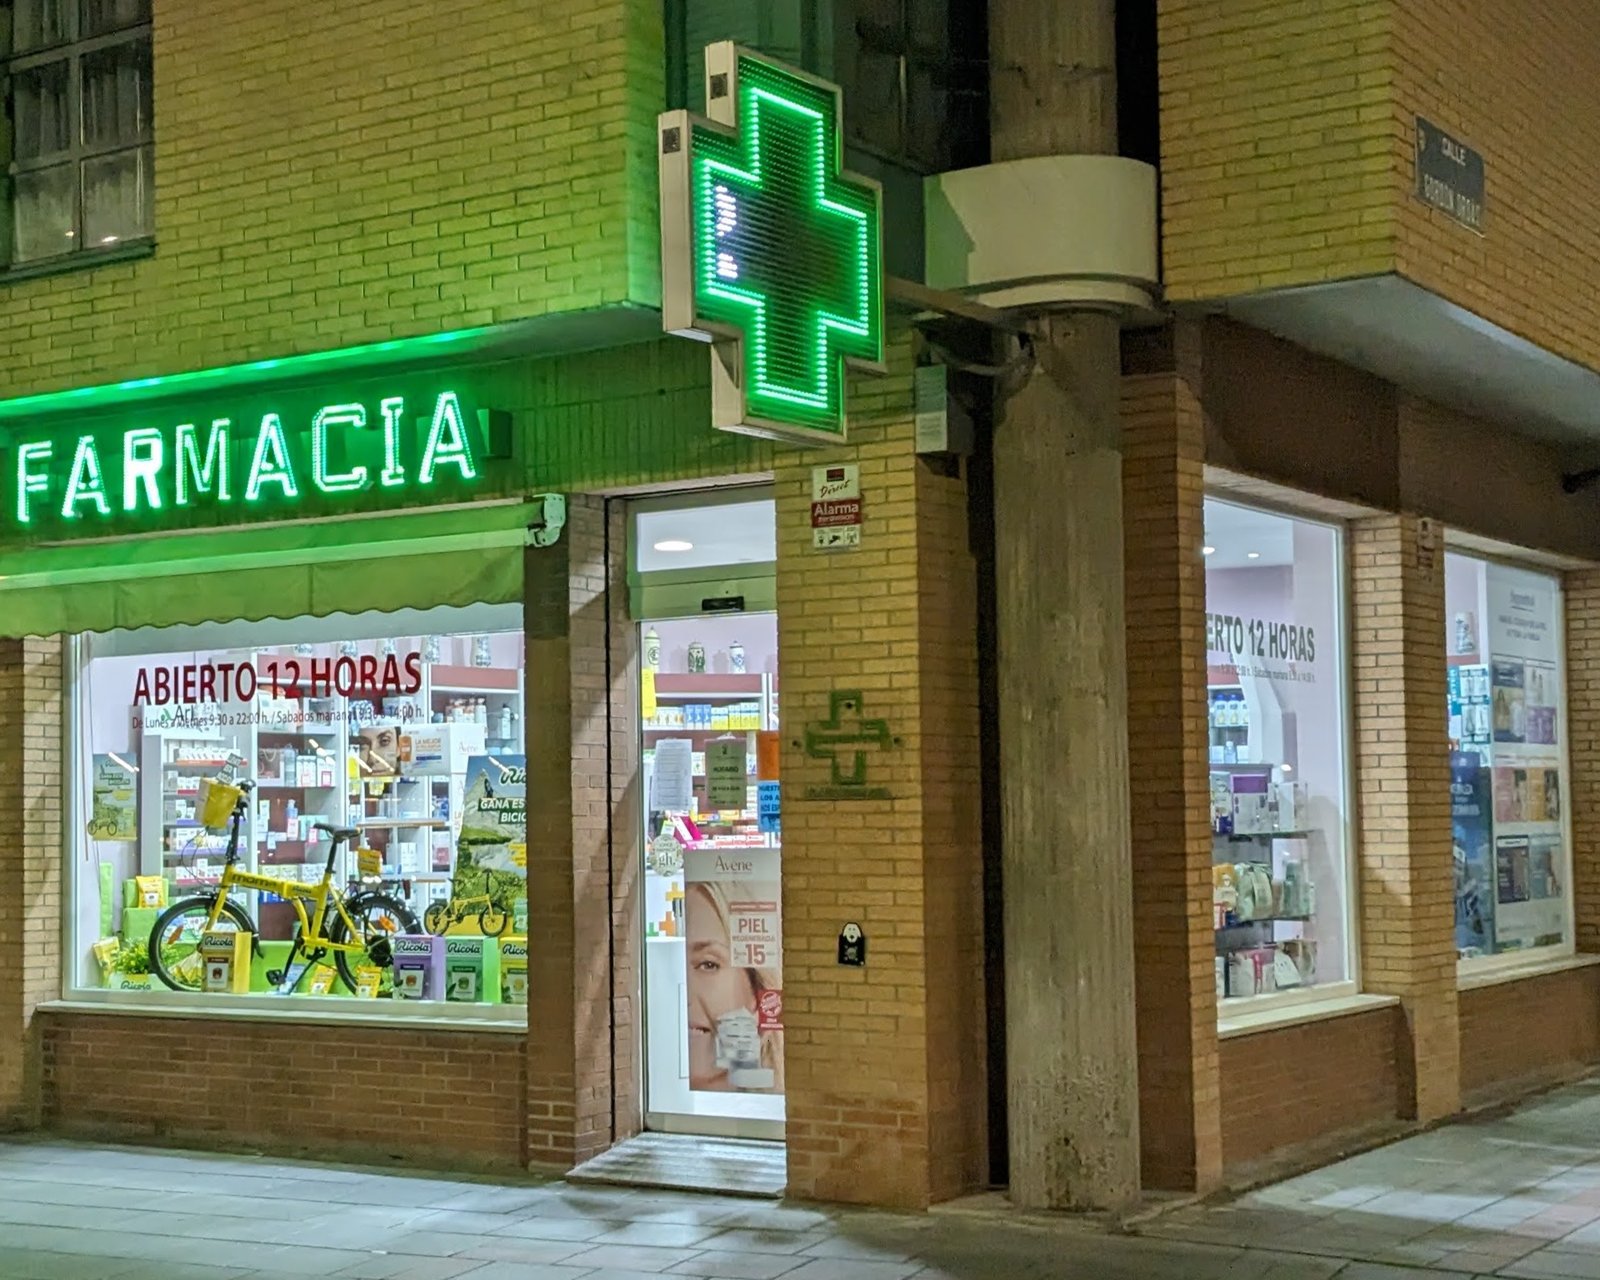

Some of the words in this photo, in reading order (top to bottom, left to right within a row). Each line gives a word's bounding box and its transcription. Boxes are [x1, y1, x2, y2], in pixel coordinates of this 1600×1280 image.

[17, 391, 476, 522] FARMACIA
[814, 502, 859, 517] Alarma
[1248, 618, 1265, 657] 12
[1269, 621, 1315, 663] HORAS
[132, 661, 257, 707] ABIERTO
[267, 660, 303, 700] 12
[310, 652, 422, 698] HORAS
[132, 717, 143, 729] De
[145, 716, 169, 729] Lunes
[210, 713, 228, 726] 9:30
[229, 716, 234, 725] a
[236, 712, 260, 725] 22:00
[480, 799, 510, 810] GANA
[511, 798, 525, 810] ES
[738, 918, 769, 934] PIEL
[204, 936, 234, 948] Ricola
[396, 940, 430, 952] Ricola
[447, 942, 481, 954] Ricola
[745, 944, 766, 965] 15
